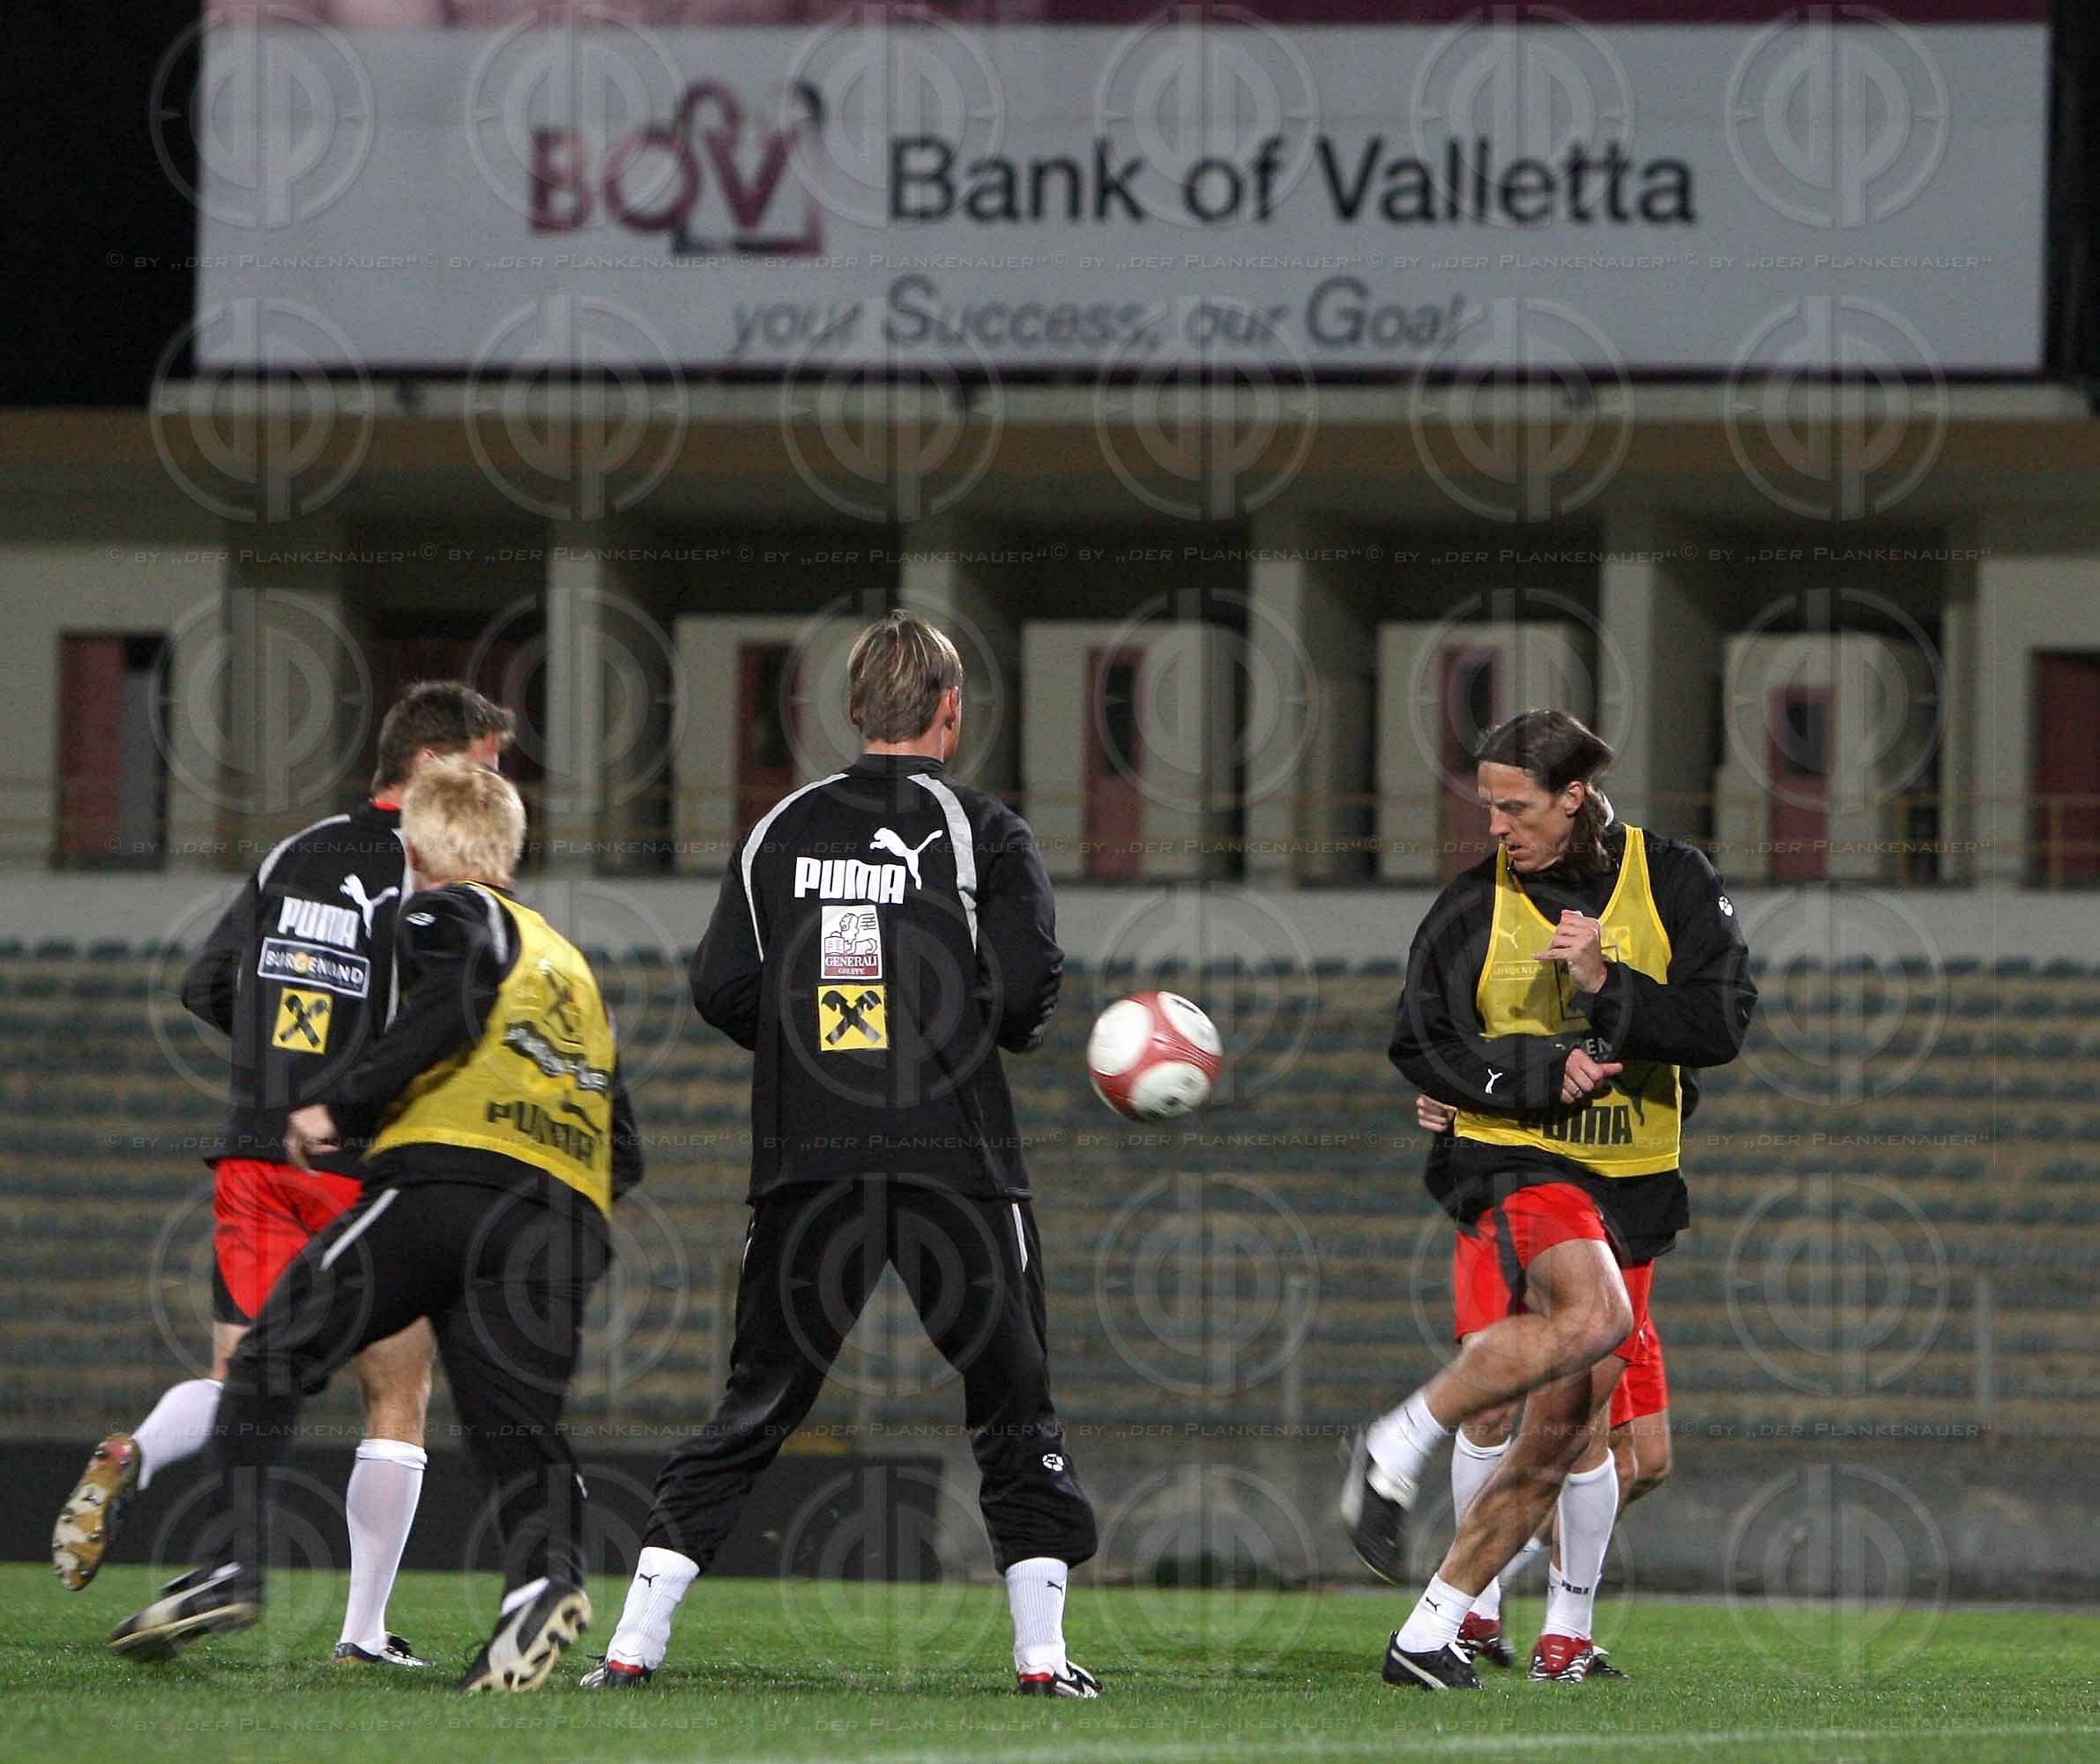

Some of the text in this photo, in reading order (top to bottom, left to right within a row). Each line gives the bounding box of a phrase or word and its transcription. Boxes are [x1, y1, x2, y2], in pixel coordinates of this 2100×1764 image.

[532, 128, 798, 236] BOV
[889, 135, 1698, 225] Bank of Valletta
[730, 300, 861, 357] your
[1184, 302, 1289, 349] our
[793, 856, 906, 904] PUMA
[278, 896, 360, 950] PUMA
[824, 955, 878, 968] GENERALI
[487, 1099, 597, 1167] PUMA
[1536, 1104, 1633, 1145] UMA
